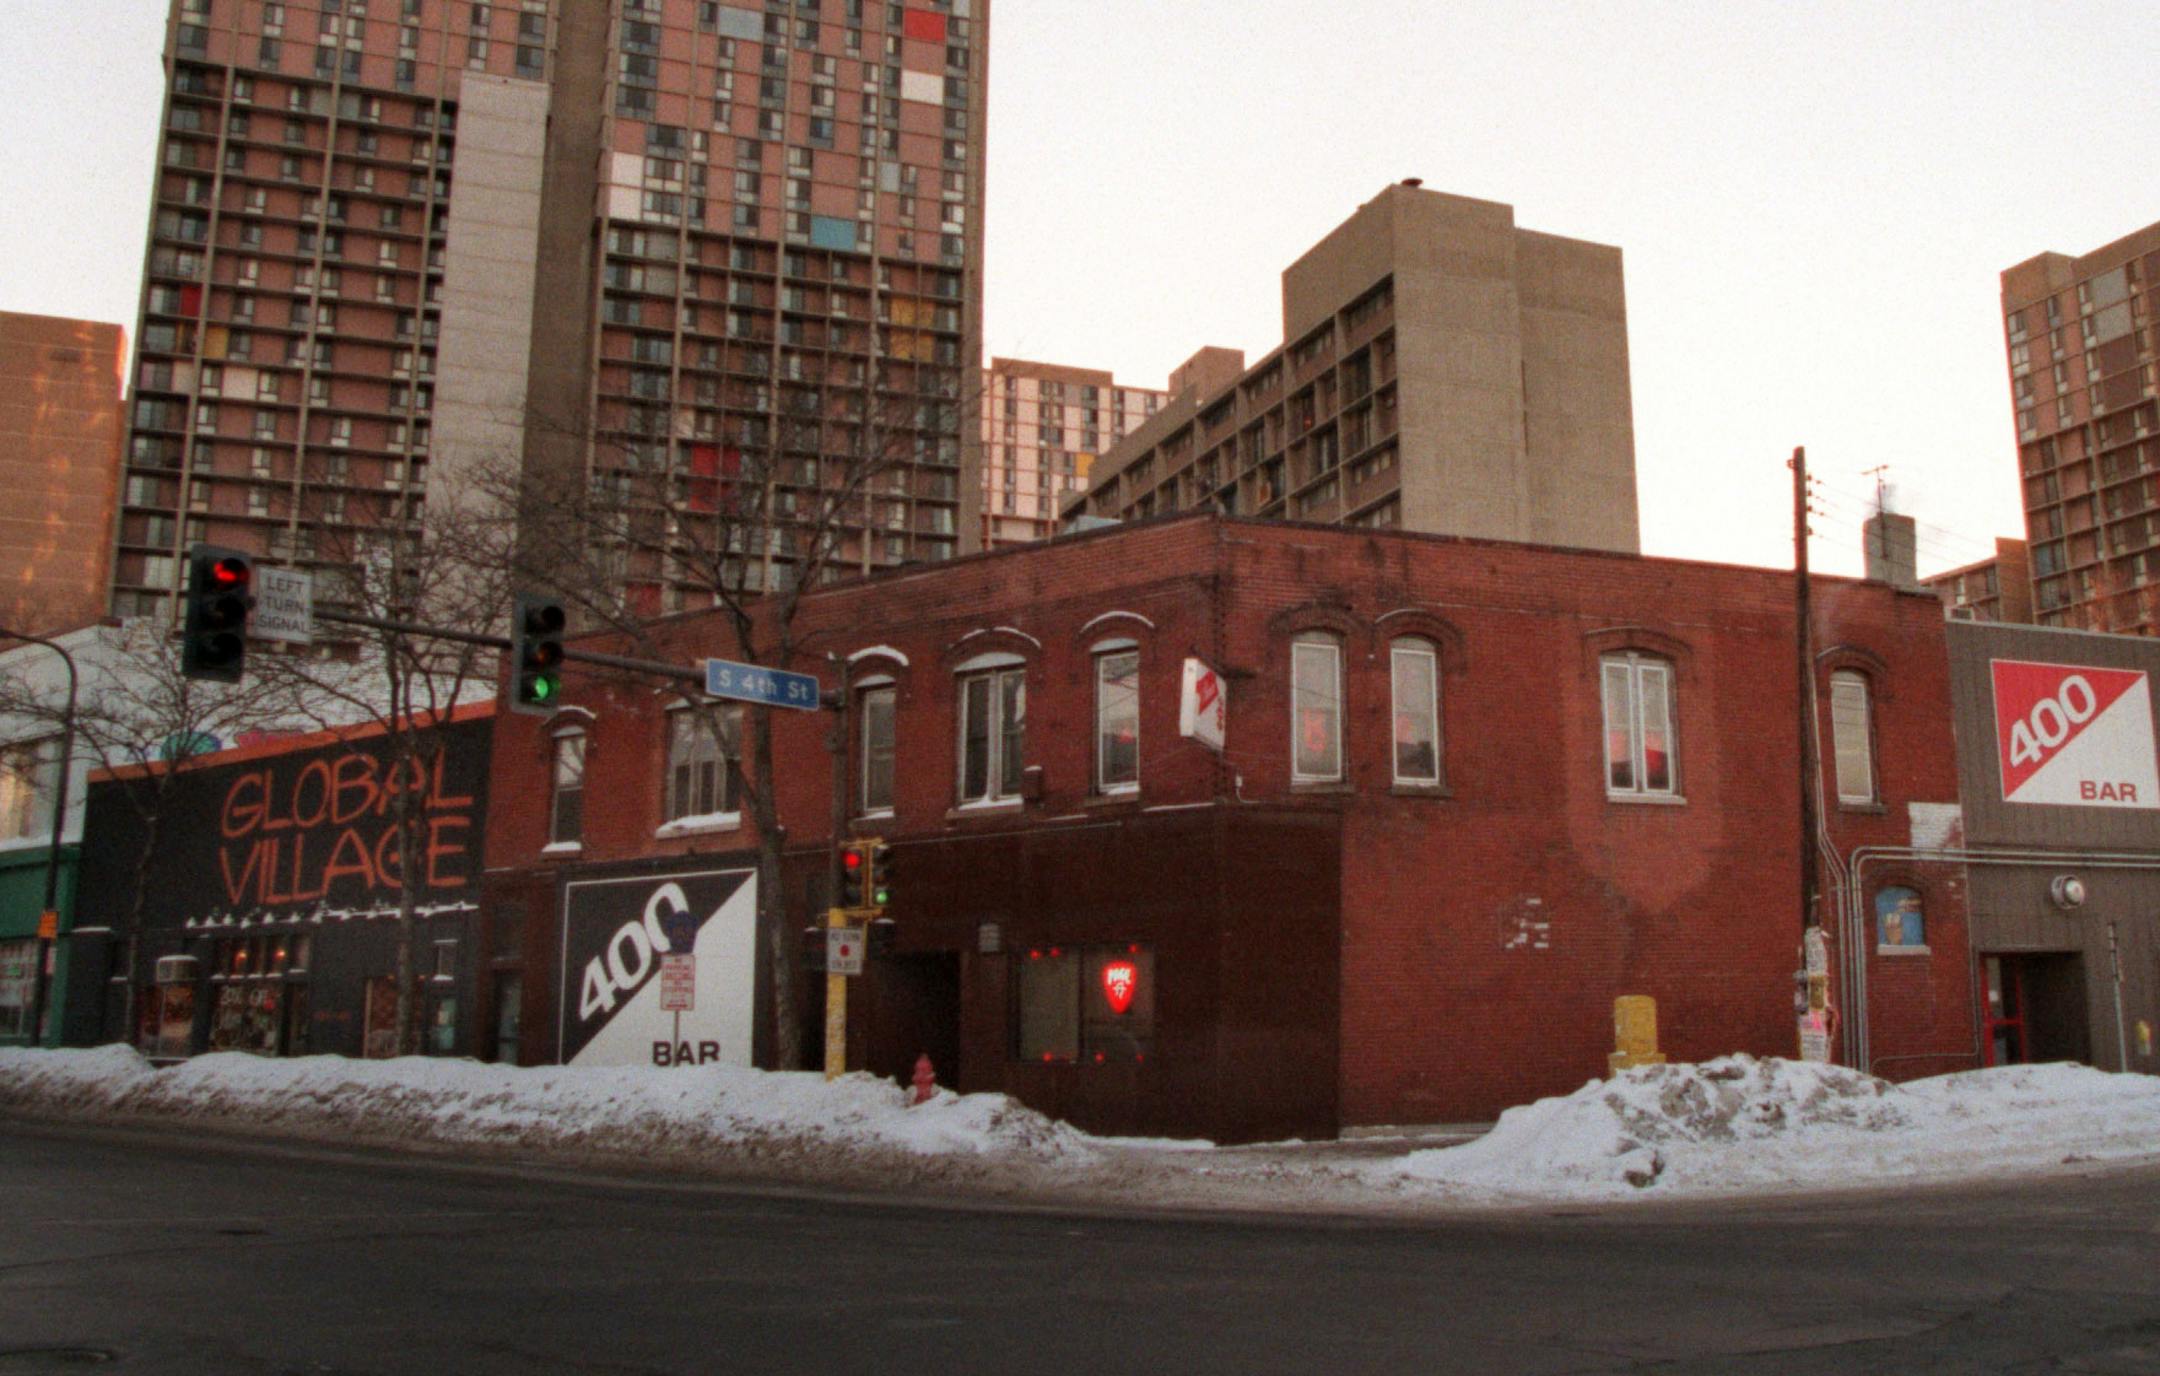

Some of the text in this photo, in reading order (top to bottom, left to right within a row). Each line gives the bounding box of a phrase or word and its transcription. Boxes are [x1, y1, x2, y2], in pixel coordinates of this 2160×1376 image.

[267, 576, 305, 592] LEFT
[266, 596, 305, 615] TURN
[258, 614, 309, 634] SIGNAL
[719, 669, 809, 700] S 4th St
[2010, 674, 2097, 768] 400
[222, 747, 473, 838] GLOBAL
[2079, 779, 2138, 803] BAR
[220, 815, 471, 905] VILLAGE
[579, 882, 690, 1022] 400
[652, 1040, 720, 1068] BAR
